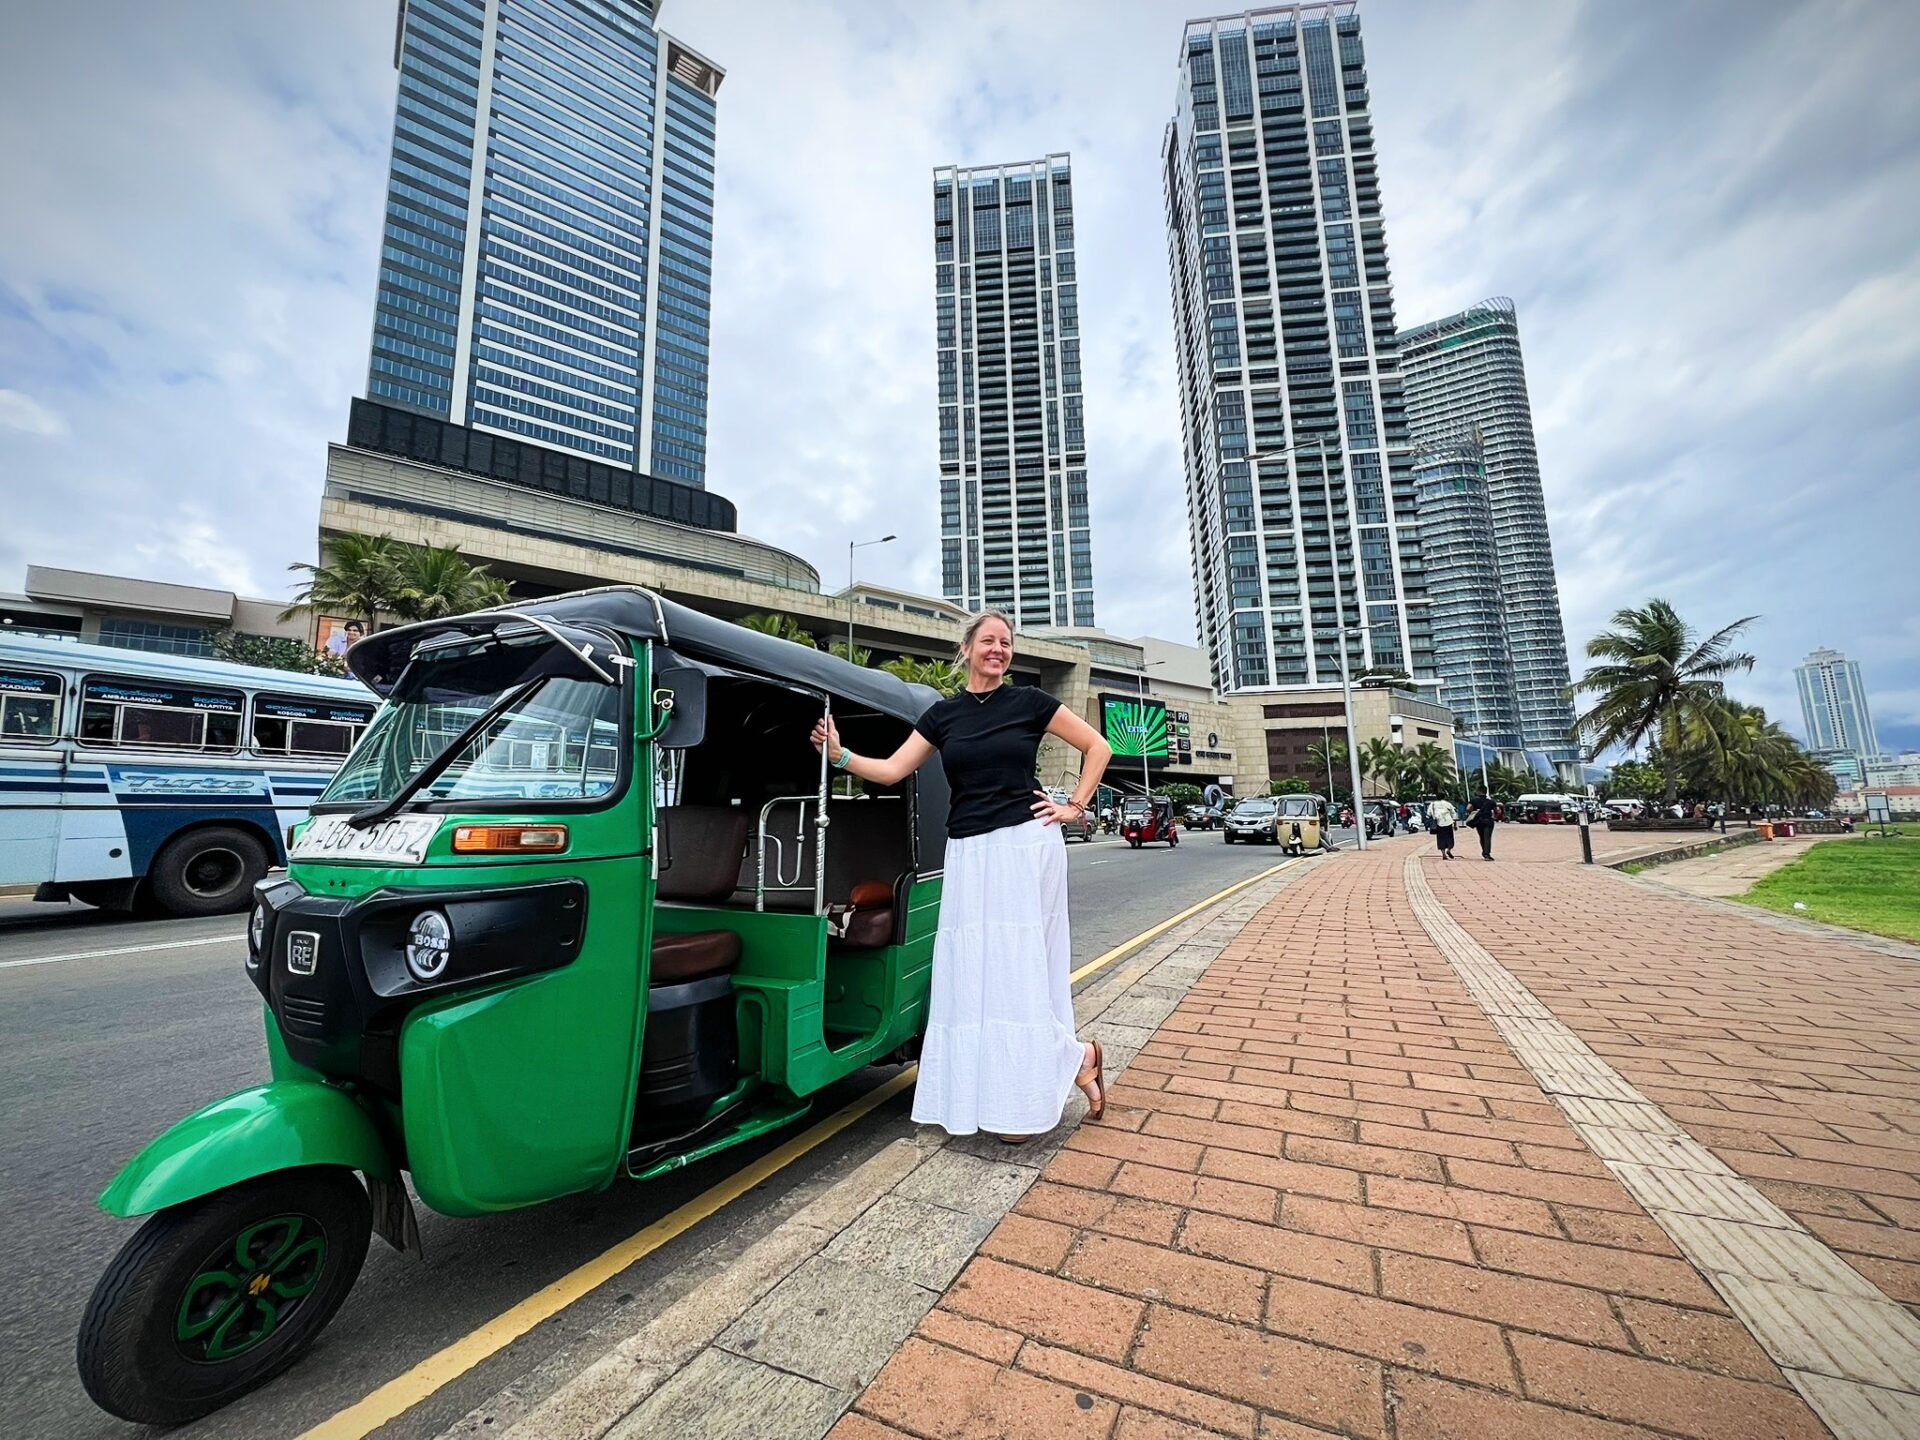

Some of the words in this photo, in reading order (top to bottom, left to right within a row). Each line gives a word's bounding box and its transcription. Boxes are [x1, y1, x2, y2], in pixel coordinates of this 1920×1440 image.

[0, 683, 42, 692] KADUWA
[101, 693, 163, 704] AMBALANGODA
[194, 702, 234, 711] BALAPITIYA
[277, 710, 307, 718] KOSGODA
[330, 715, 364, 723] ALUTHGAMA
[1127, 725, 1149, 734] EXTRA
[126, 775, 255, 790] Turbo
[360, 819, 433, 855] 5052
[292, 945, 312, 966] RE
